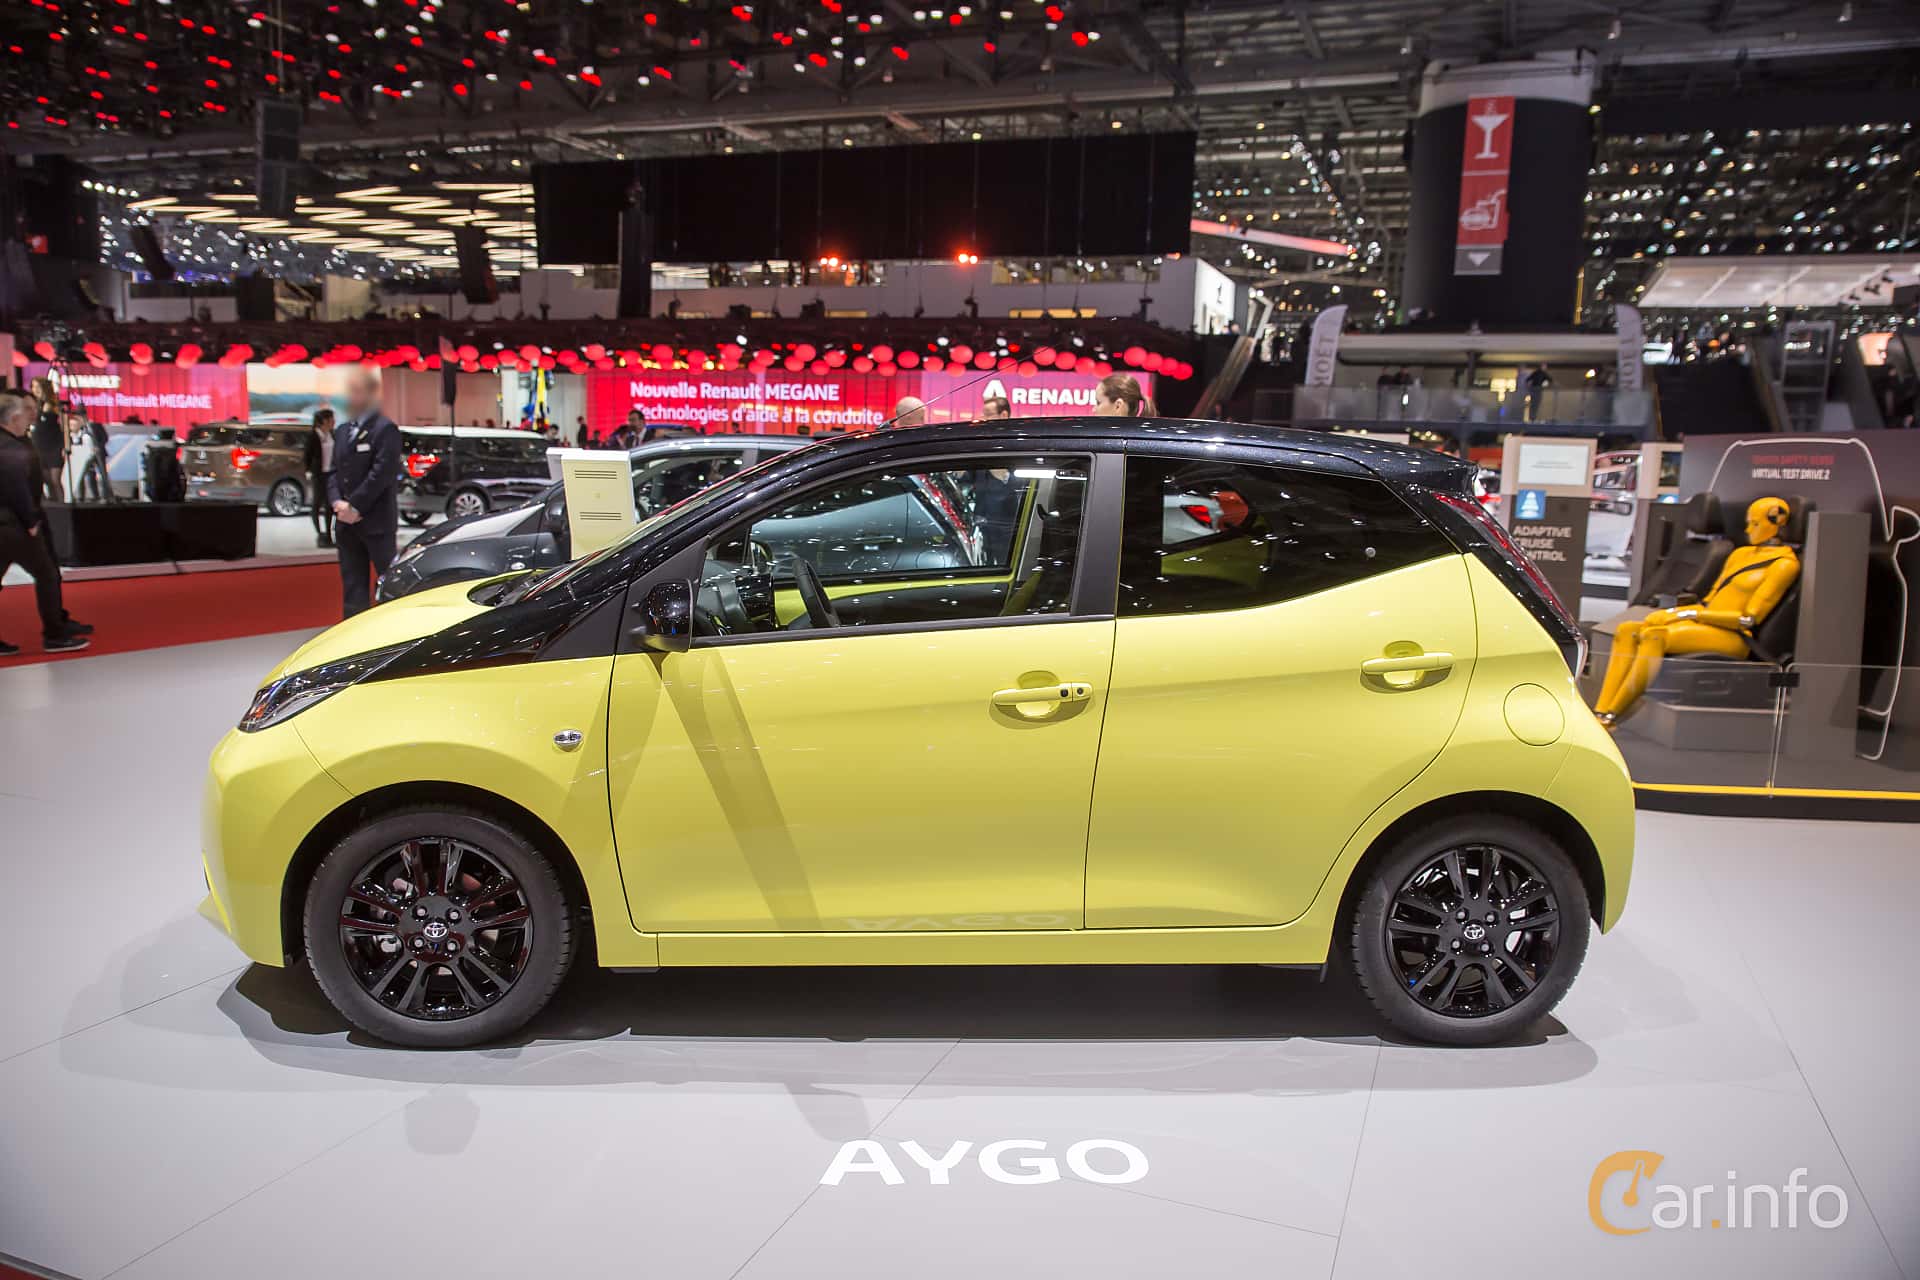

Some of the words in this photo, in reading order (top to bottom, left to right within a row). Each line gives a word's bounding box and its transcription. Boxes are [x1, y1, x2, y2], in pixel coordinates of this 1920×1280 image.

[630, 382, 698, 399] Nouvelle
[700, 383, 761, 399] Renault
[764, 384, 839, 401] MEGANE
[1012, 387, 1097, 406] RENAUL
[633, 403, 729, 425] Technologies
[813, 407, 884, 426] conduite
[1513, 525, 1572, 538] ADAPTIVE
[1526, 549, 1567, 561] NTROL
[819, 1138, 1149, 1185] AYGO
